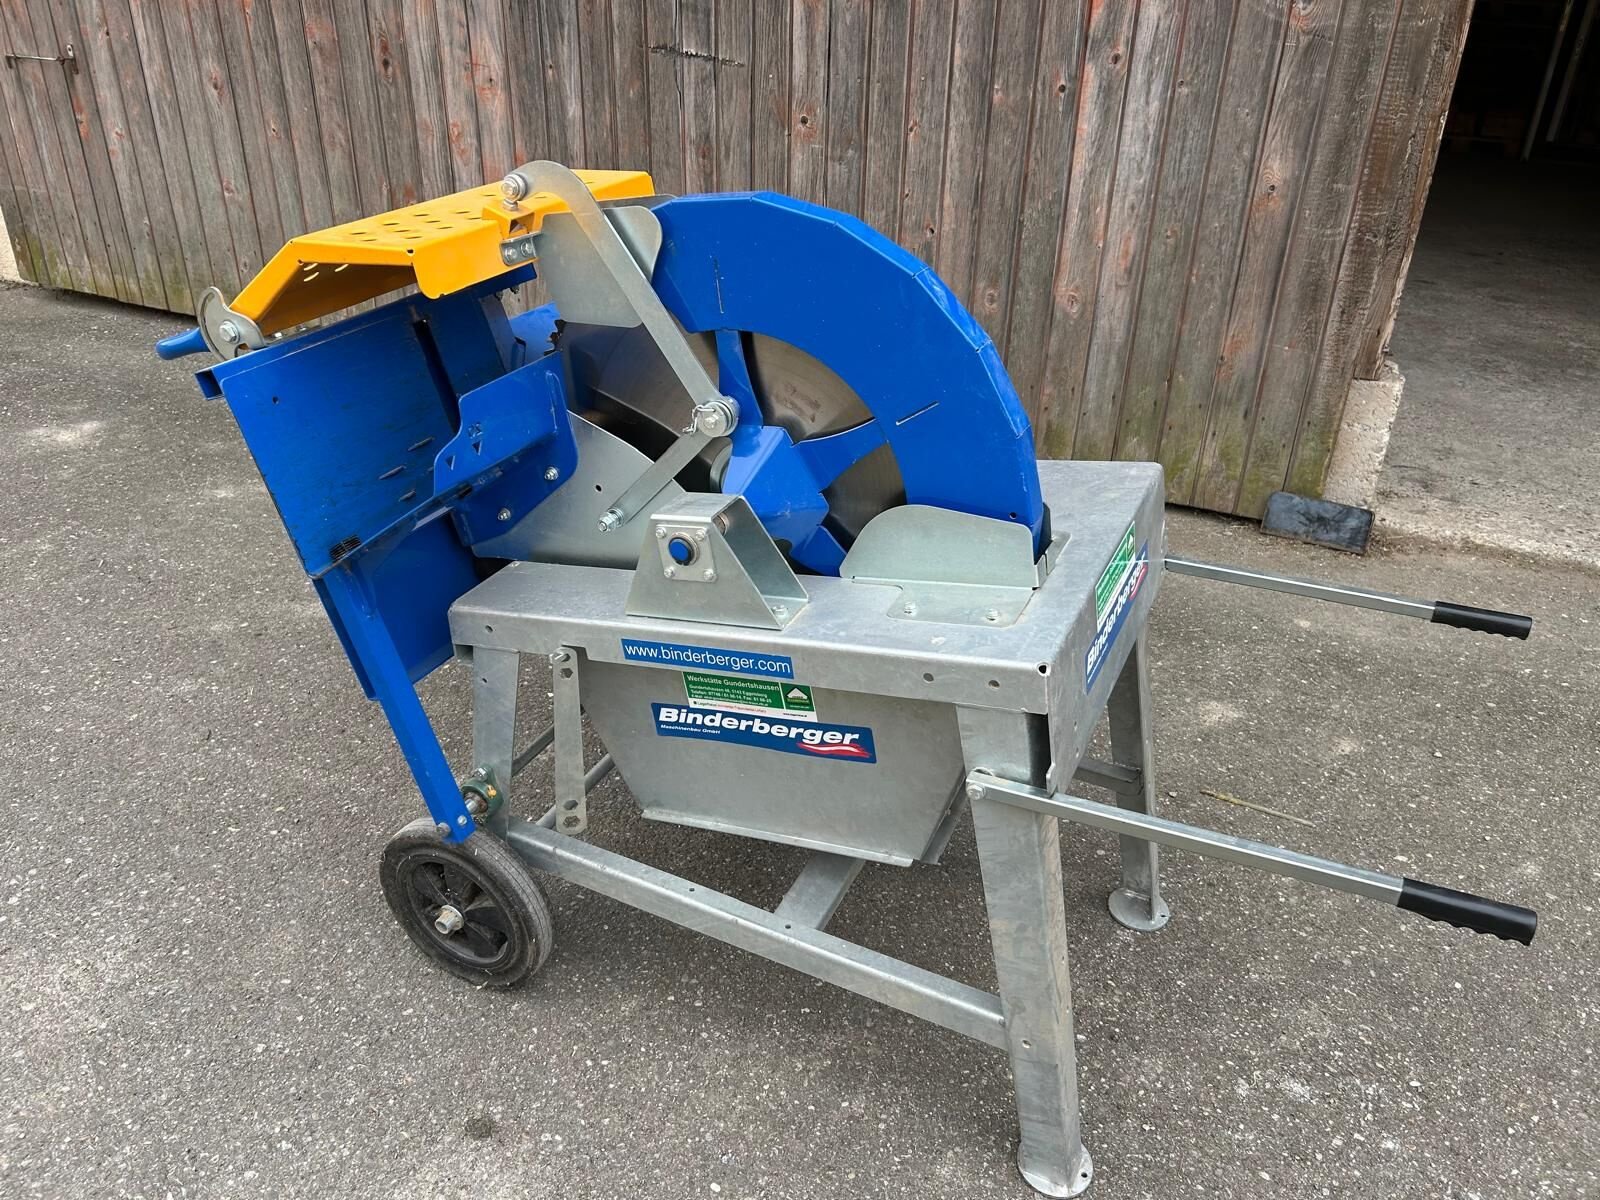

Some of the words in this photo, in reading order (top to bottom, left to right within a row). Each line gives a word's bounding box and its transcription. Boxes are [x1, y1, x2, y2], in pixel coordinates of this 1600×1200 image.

[1086, 551, 1147, 675] Binderberger
[624, 644, 791, 673] www.binderberger.com
[724, 679, 779, 691] Gundertshausen
[658, 707, 859, 744] Binderberger
[660, 724, 701, 733] Maschinenbau
